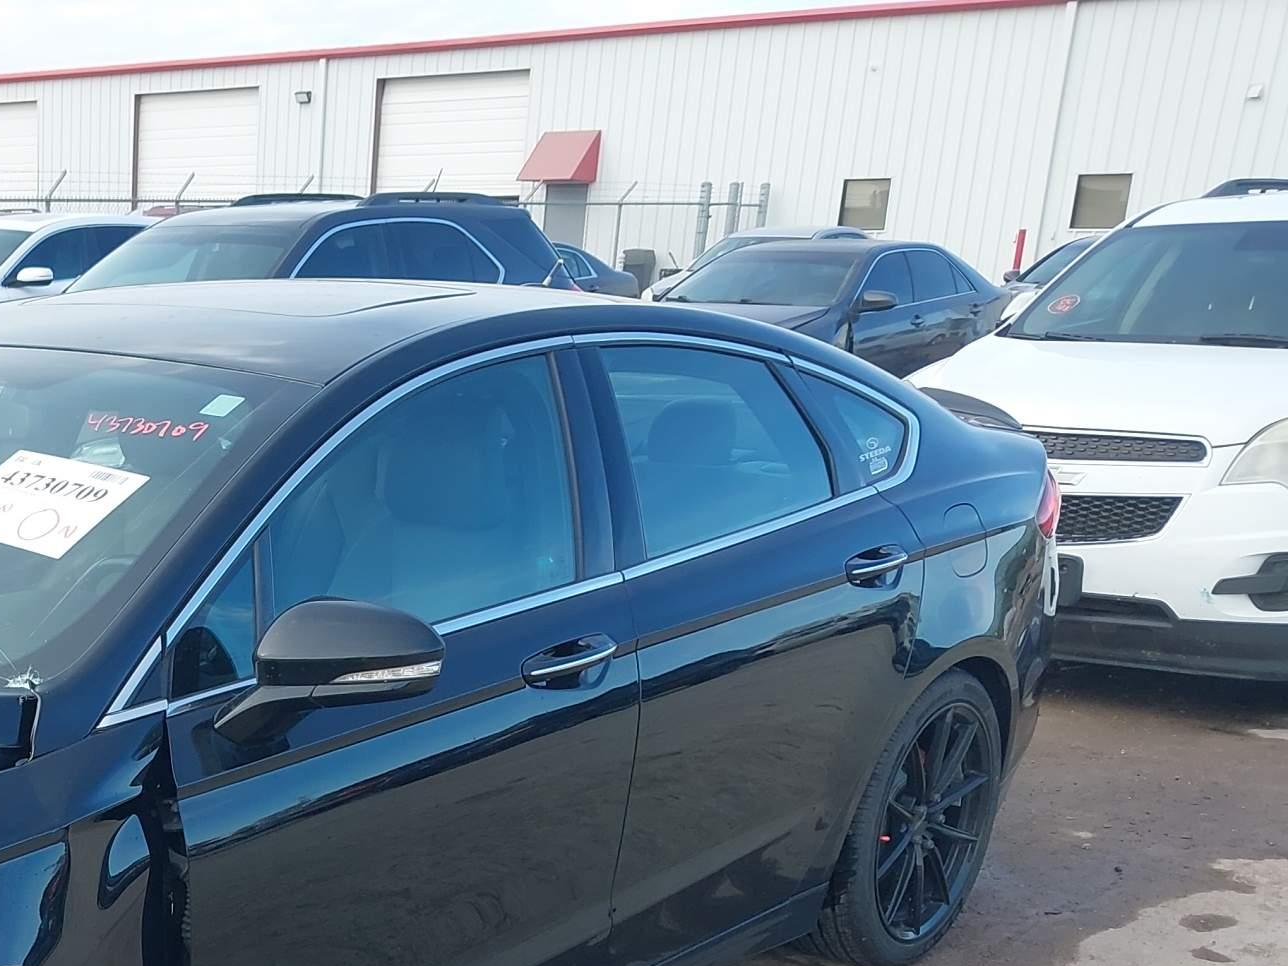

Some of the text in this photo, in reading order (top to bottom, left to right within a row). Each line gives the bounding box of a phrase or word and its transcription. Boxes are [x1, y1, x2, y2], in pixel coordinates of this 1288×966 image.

[88, 413, 209, 441] 43730709
[859, 446, 891, 462] STEEDA
[1, 470, 109, 503] 43730709
